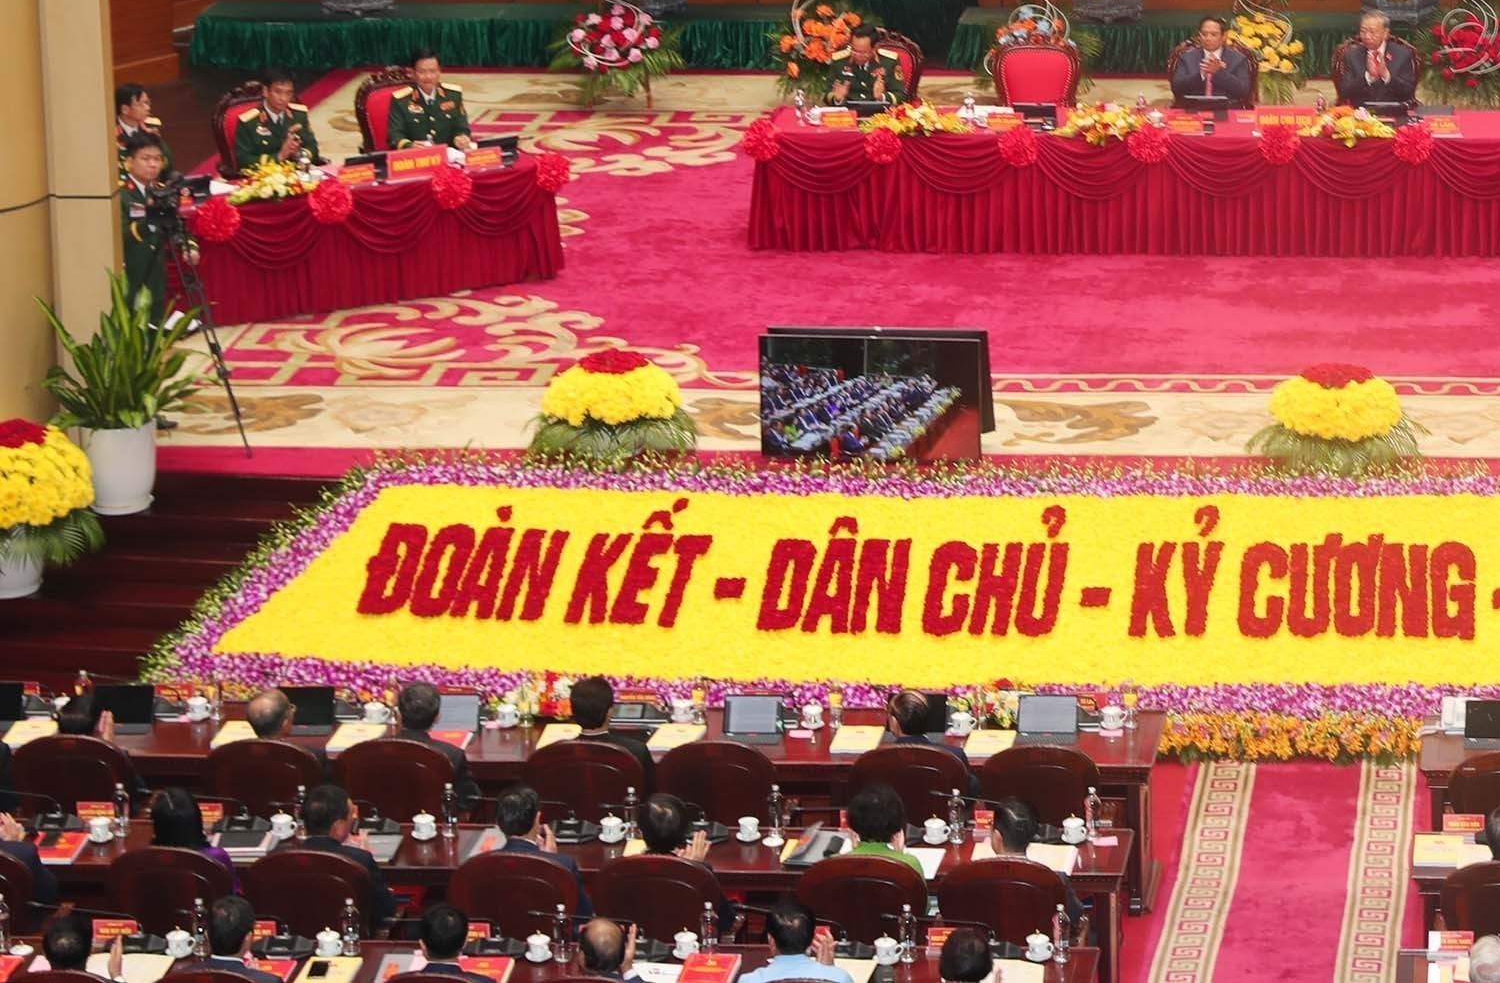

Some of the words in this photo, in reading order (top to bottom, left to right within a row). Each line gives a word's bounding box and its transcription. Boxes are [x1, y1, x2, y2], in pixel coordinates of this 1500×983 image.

[564, 498, 713, 626] KẾT
[714, 577, 746, 600] -
[756, 516, 912, 634] DÂN
[921, 505, 1070, 637] CHỦ
[1081, 588, 1110, 606] -
[1129, 506, 1223, 637] KỶ
[1238, 534, 1475, 639] CƯƠNG
